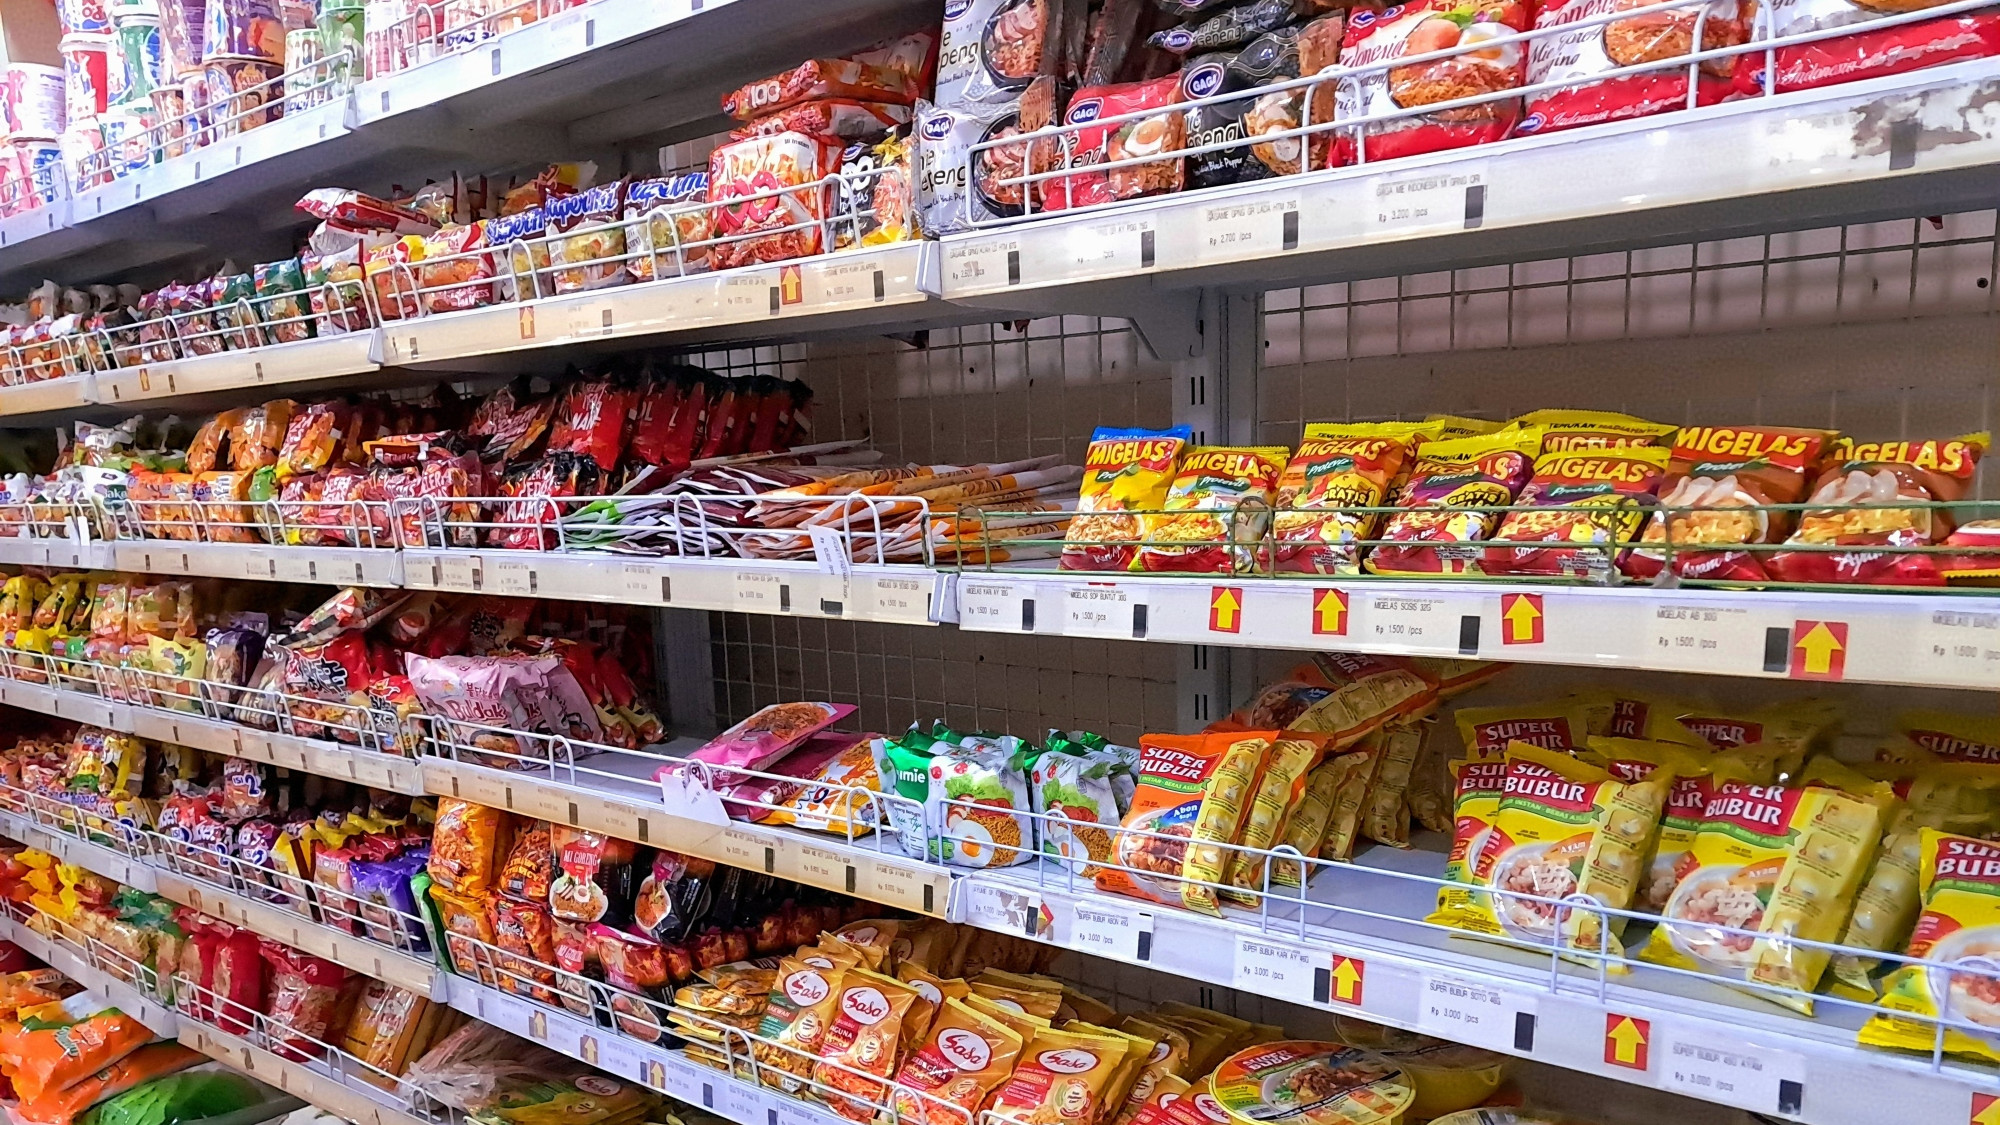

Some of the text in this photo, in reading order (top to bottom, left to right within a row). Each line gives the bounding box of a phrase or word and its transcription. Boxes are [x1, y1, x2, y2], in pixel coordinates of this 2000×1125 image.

[938, 42, 979, 73] peng
[751, 81, 780, 108] 100
[486, 208, 547, 245] Superm
[1295, 440, 1388, 462] MIGELAS
[1676, 427, 1810, 456] MIGELAS
[1087, 441, 1168, 467] MIGELAS
[1181, 453, 1272, 481] MIGELAS
[1537, 457, 1648, 482] MIGELAS
[1090, 592, 1098, 600] SOP
[1100, 593, 1116, 601] BUNTUT
[1374, 601, 1397, 610] MIGELAS
[1401, 602, 1417, 611] SOSIS
[1073, 612, 1079, 620] Rp
[1096, 613, 1106, 621] /pcs
[1657, 610, 1686, 619] MIGELAS
[1375, 625, 1383, 634] Rp
[1408, 626, 1422, 636] /pcs
[1659, 636, 1669, 647] Rp
[1933, 645, 1945, 656] Rp
[1486, 721, 1556, 741] SUPER
[1145, 747, 1207, 769] SUPER
[1140, 759, 1202, 780] BUBUR
[245, 774, 260, 797] 2
[1504, 776, 1586, 803] BUBUR
[1721, 783, 1786, 803] SUER
[1173, 803, 1198, 818] Abon
[1704, 798, 1783, 826] BUBUR
[563, 850, 598, 866] MI GORENG
[1937, 858, 2000, 877] BUB
[1080, 933, 1086, 941] Rp
[1103, 935, 1113, 944] /pcs
[1243, 944, 1258, 953] SUPER
[1259, 946, 1275, 957] BUBUR
[1276, 949, 1288, 959] KARI
[1290, 952, 1298, 961] AY
[1243, 966, 1284, 981] Rp 3.000 /pcs
[791, 975, 822, 1000] Sasa
[1430, 982, 1486, 1002] SUPER BUBUR SOTO
[845, 990, 883, 1018] Sasa
[1431, 1006, 1479, 1024] Rp 3.000 /pcs
[943, 1034, 983, 1064] Sasa
[1045, 1051, 1088, 1069] Sasa
[1675, 1071, 1684, 1081] Rp
